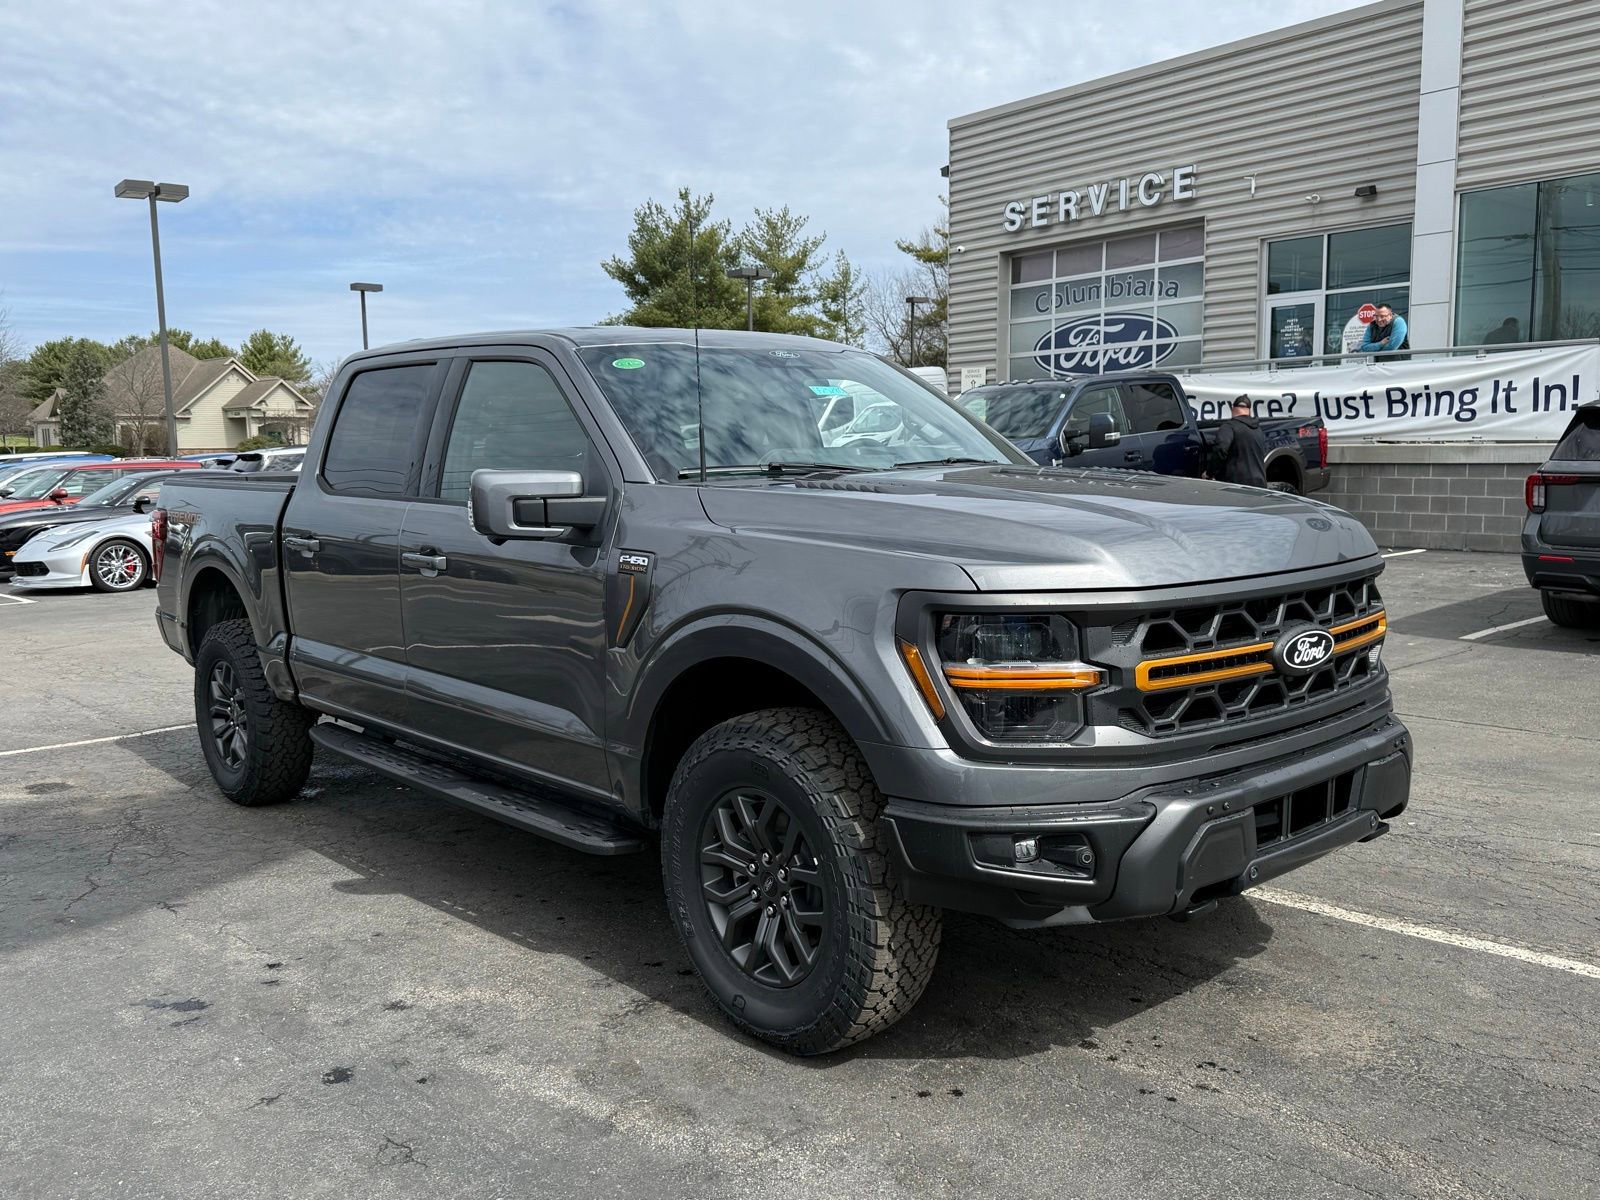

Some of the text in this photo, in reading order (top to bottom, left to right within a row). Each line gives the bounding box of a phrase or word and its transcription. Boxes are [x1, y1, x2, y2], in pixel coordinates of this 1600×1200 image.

[1003, 164, 1198, 233] SERVICE
[1034, 275, 1181, 313] Columbiana
[1359, 309, 1376, 319] STOP
[1059, 322, 1148, 368] Ford
[1186, 374, 1581, 423] Serce? Just Bring It In!
[1294, 636, 1326, 664] Ford
